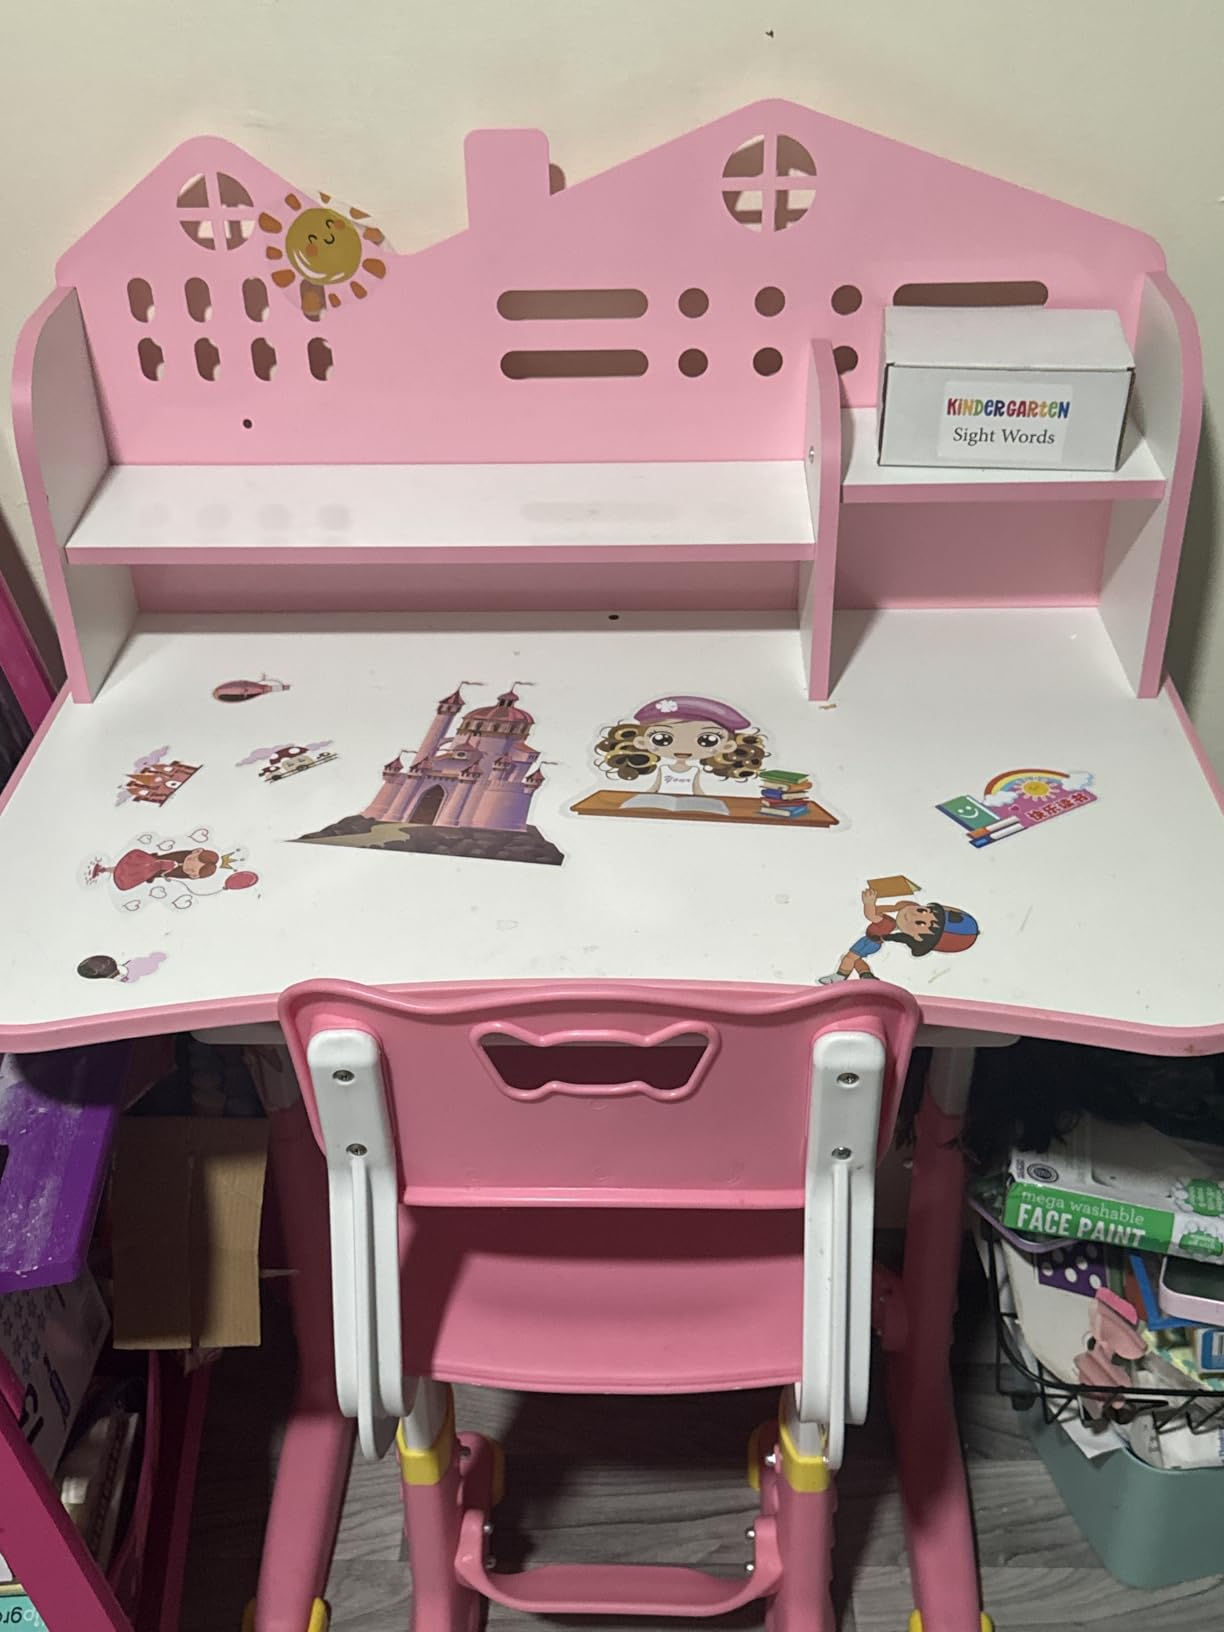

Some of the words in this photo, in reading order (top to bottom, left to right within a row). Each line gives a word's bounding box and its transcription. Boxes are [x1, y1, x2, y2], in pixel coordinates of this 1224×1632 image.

[952, 427, 995, 446] Sight
[1001, 428, 1055, 445] Words
[1017, 1203, 1073, 1239] FACE
[1077, 1216, 1146, 1248] PAINT
[1021, 1190, 1065, 1210] mega
[1069, 1199, 1145, 1226] washable
